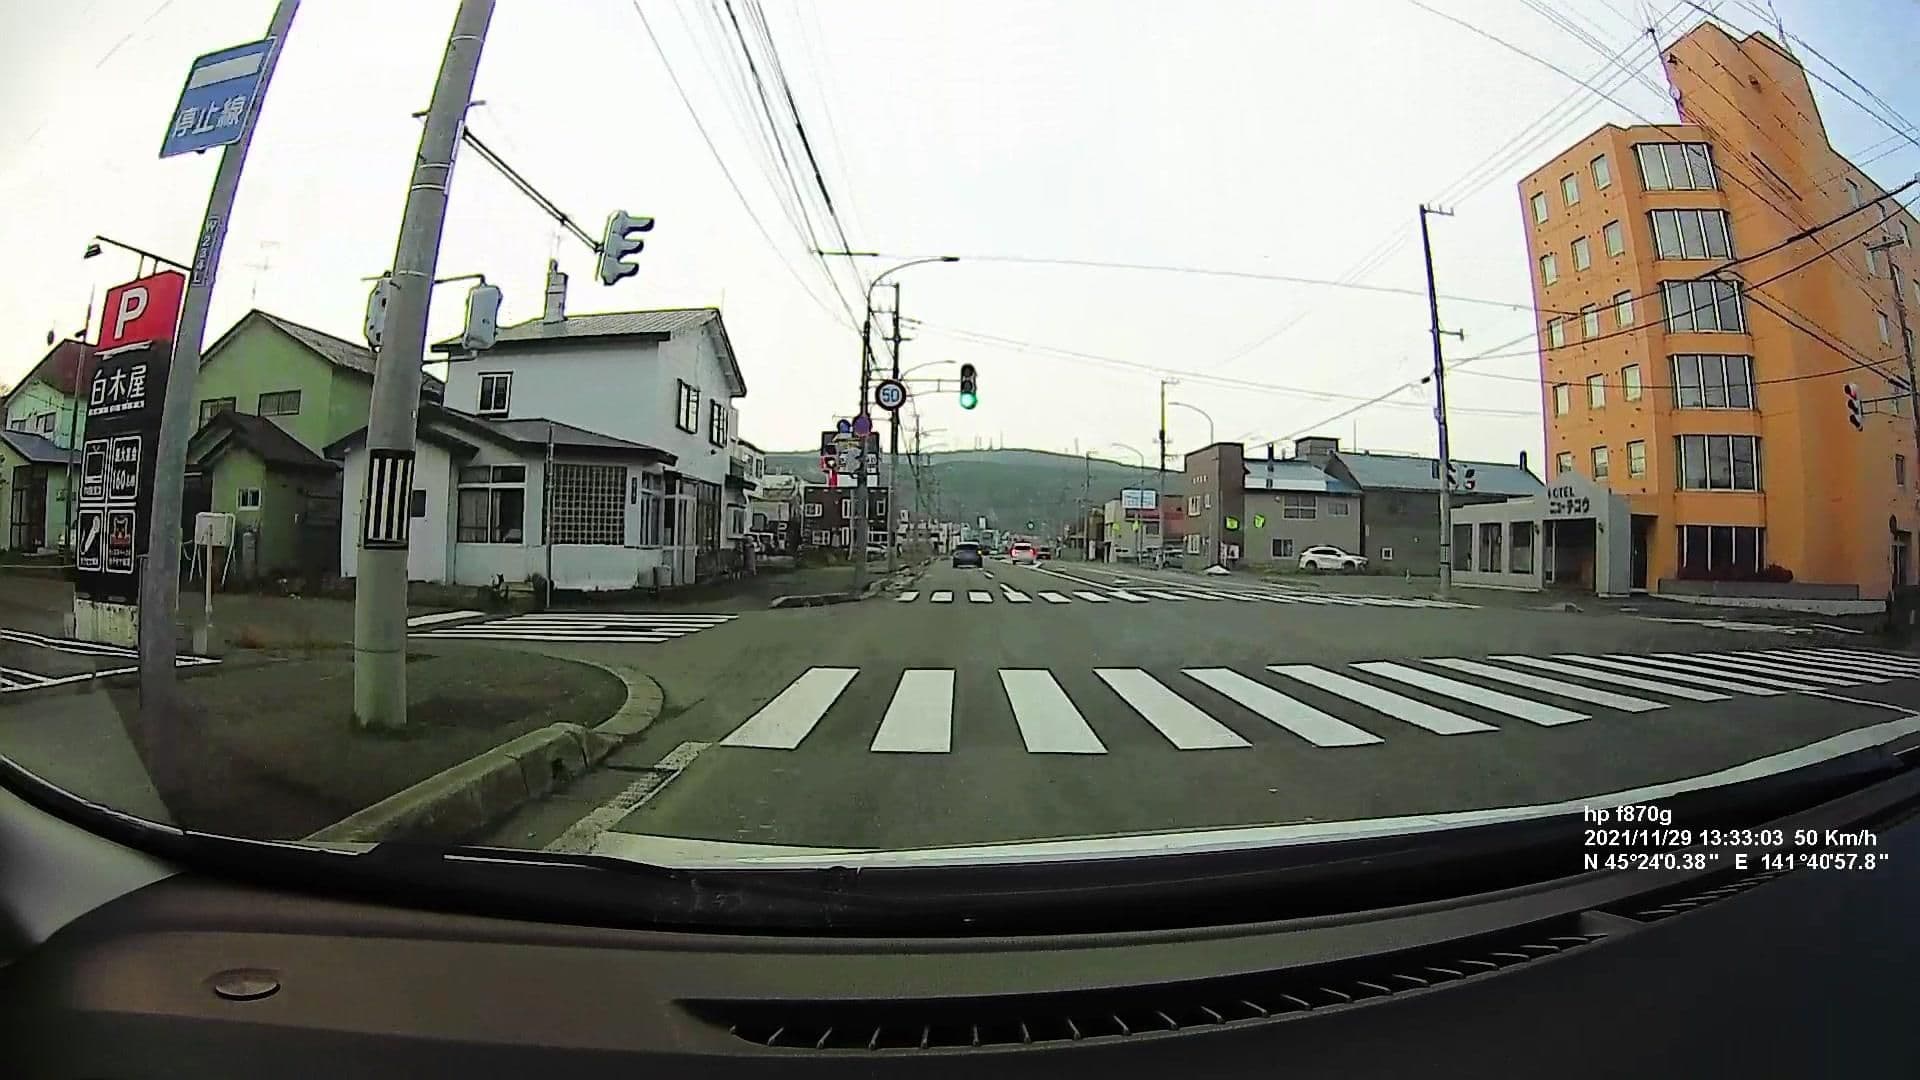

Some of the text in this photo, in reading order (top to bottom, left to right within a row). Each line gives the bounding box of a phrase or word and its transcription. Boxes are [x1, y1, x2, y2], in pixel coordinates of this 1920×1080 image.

[172, 95, 247, 138] 停止線
[114, 286, 149, 340] P
[91, 364, 147, 406] 白木屋
[881, 387, 900, 403] 50
